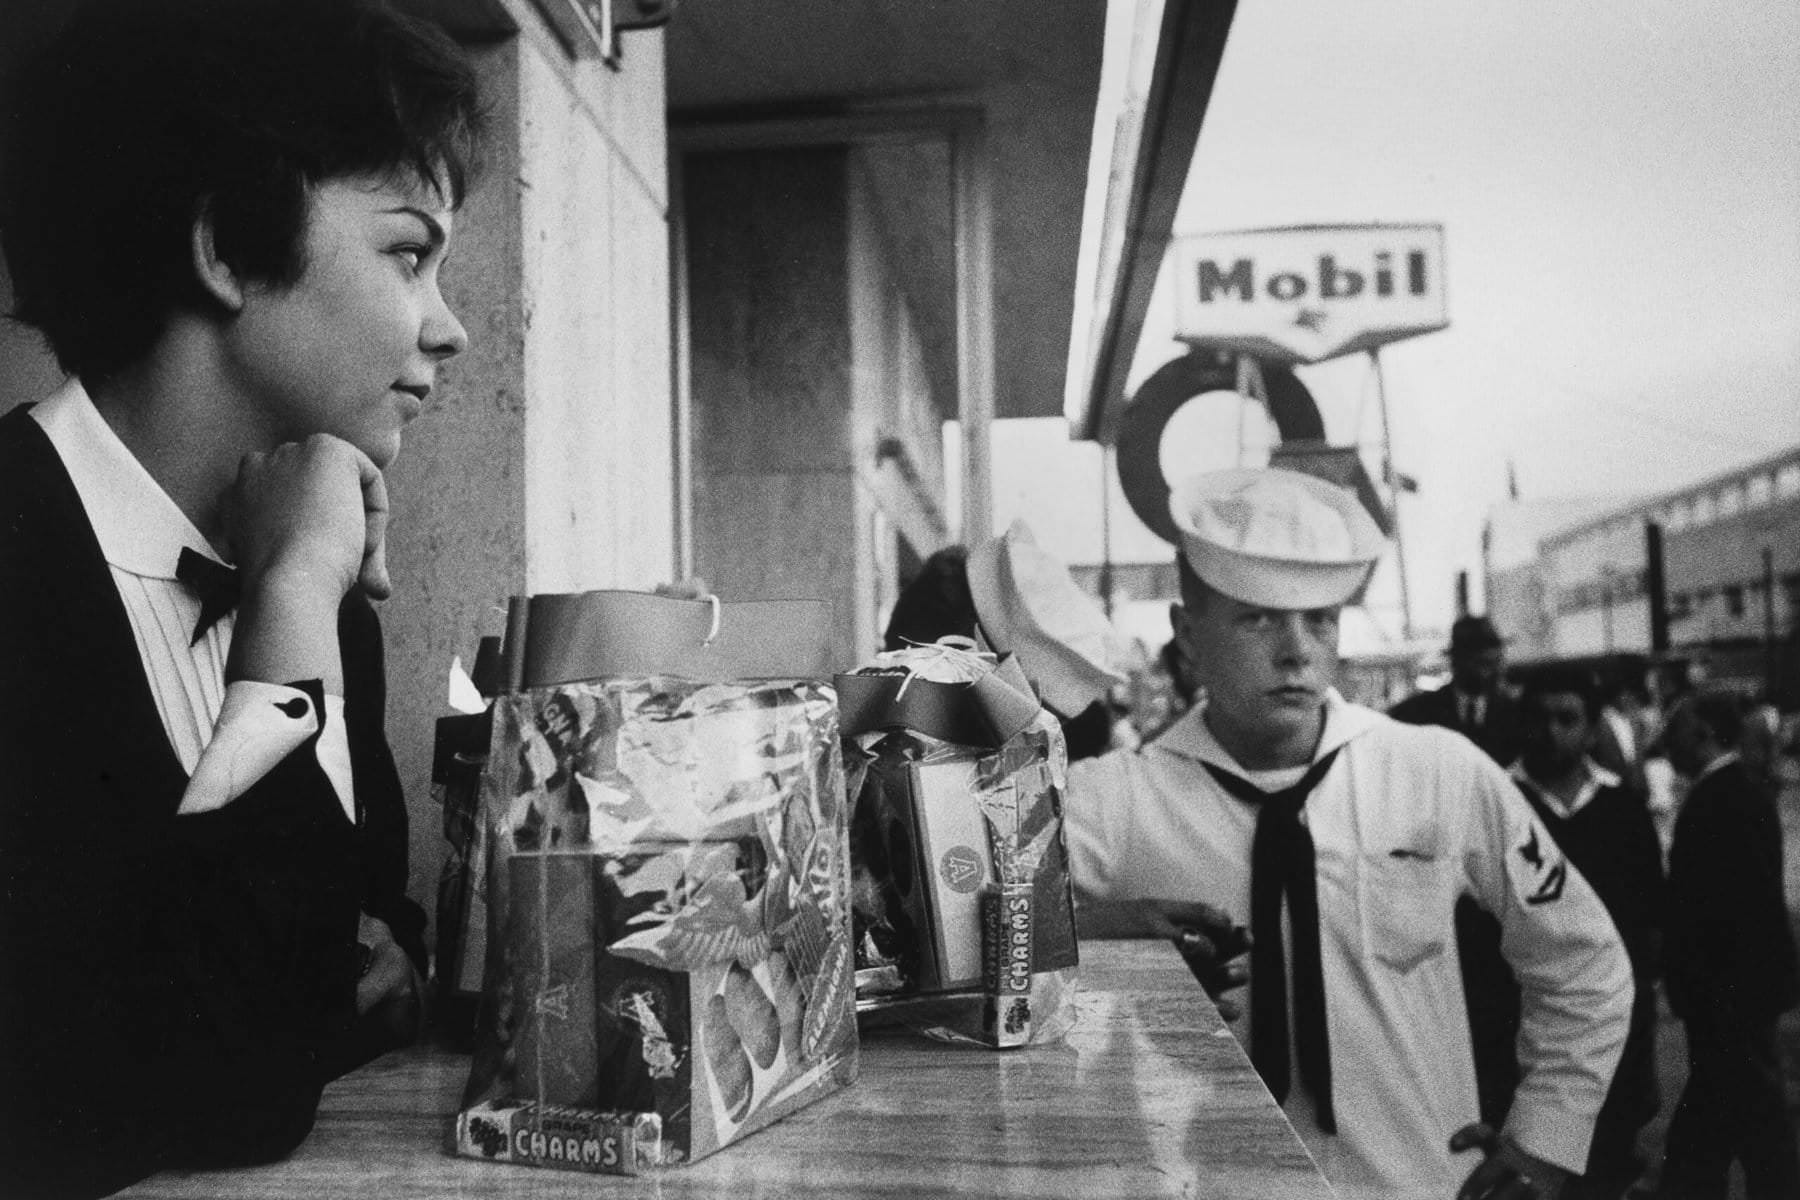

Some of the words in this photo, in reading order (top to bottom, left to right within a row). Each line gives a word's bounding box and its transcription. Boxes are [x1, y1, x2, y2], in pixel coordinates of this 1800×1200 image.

[1198, 249, 1426, 302] Mobil
[951, 857, 978, 883] A
[1009, 898, 1029, 991] CHARMS
[515, 1129, 617, 1166] CHARMS
